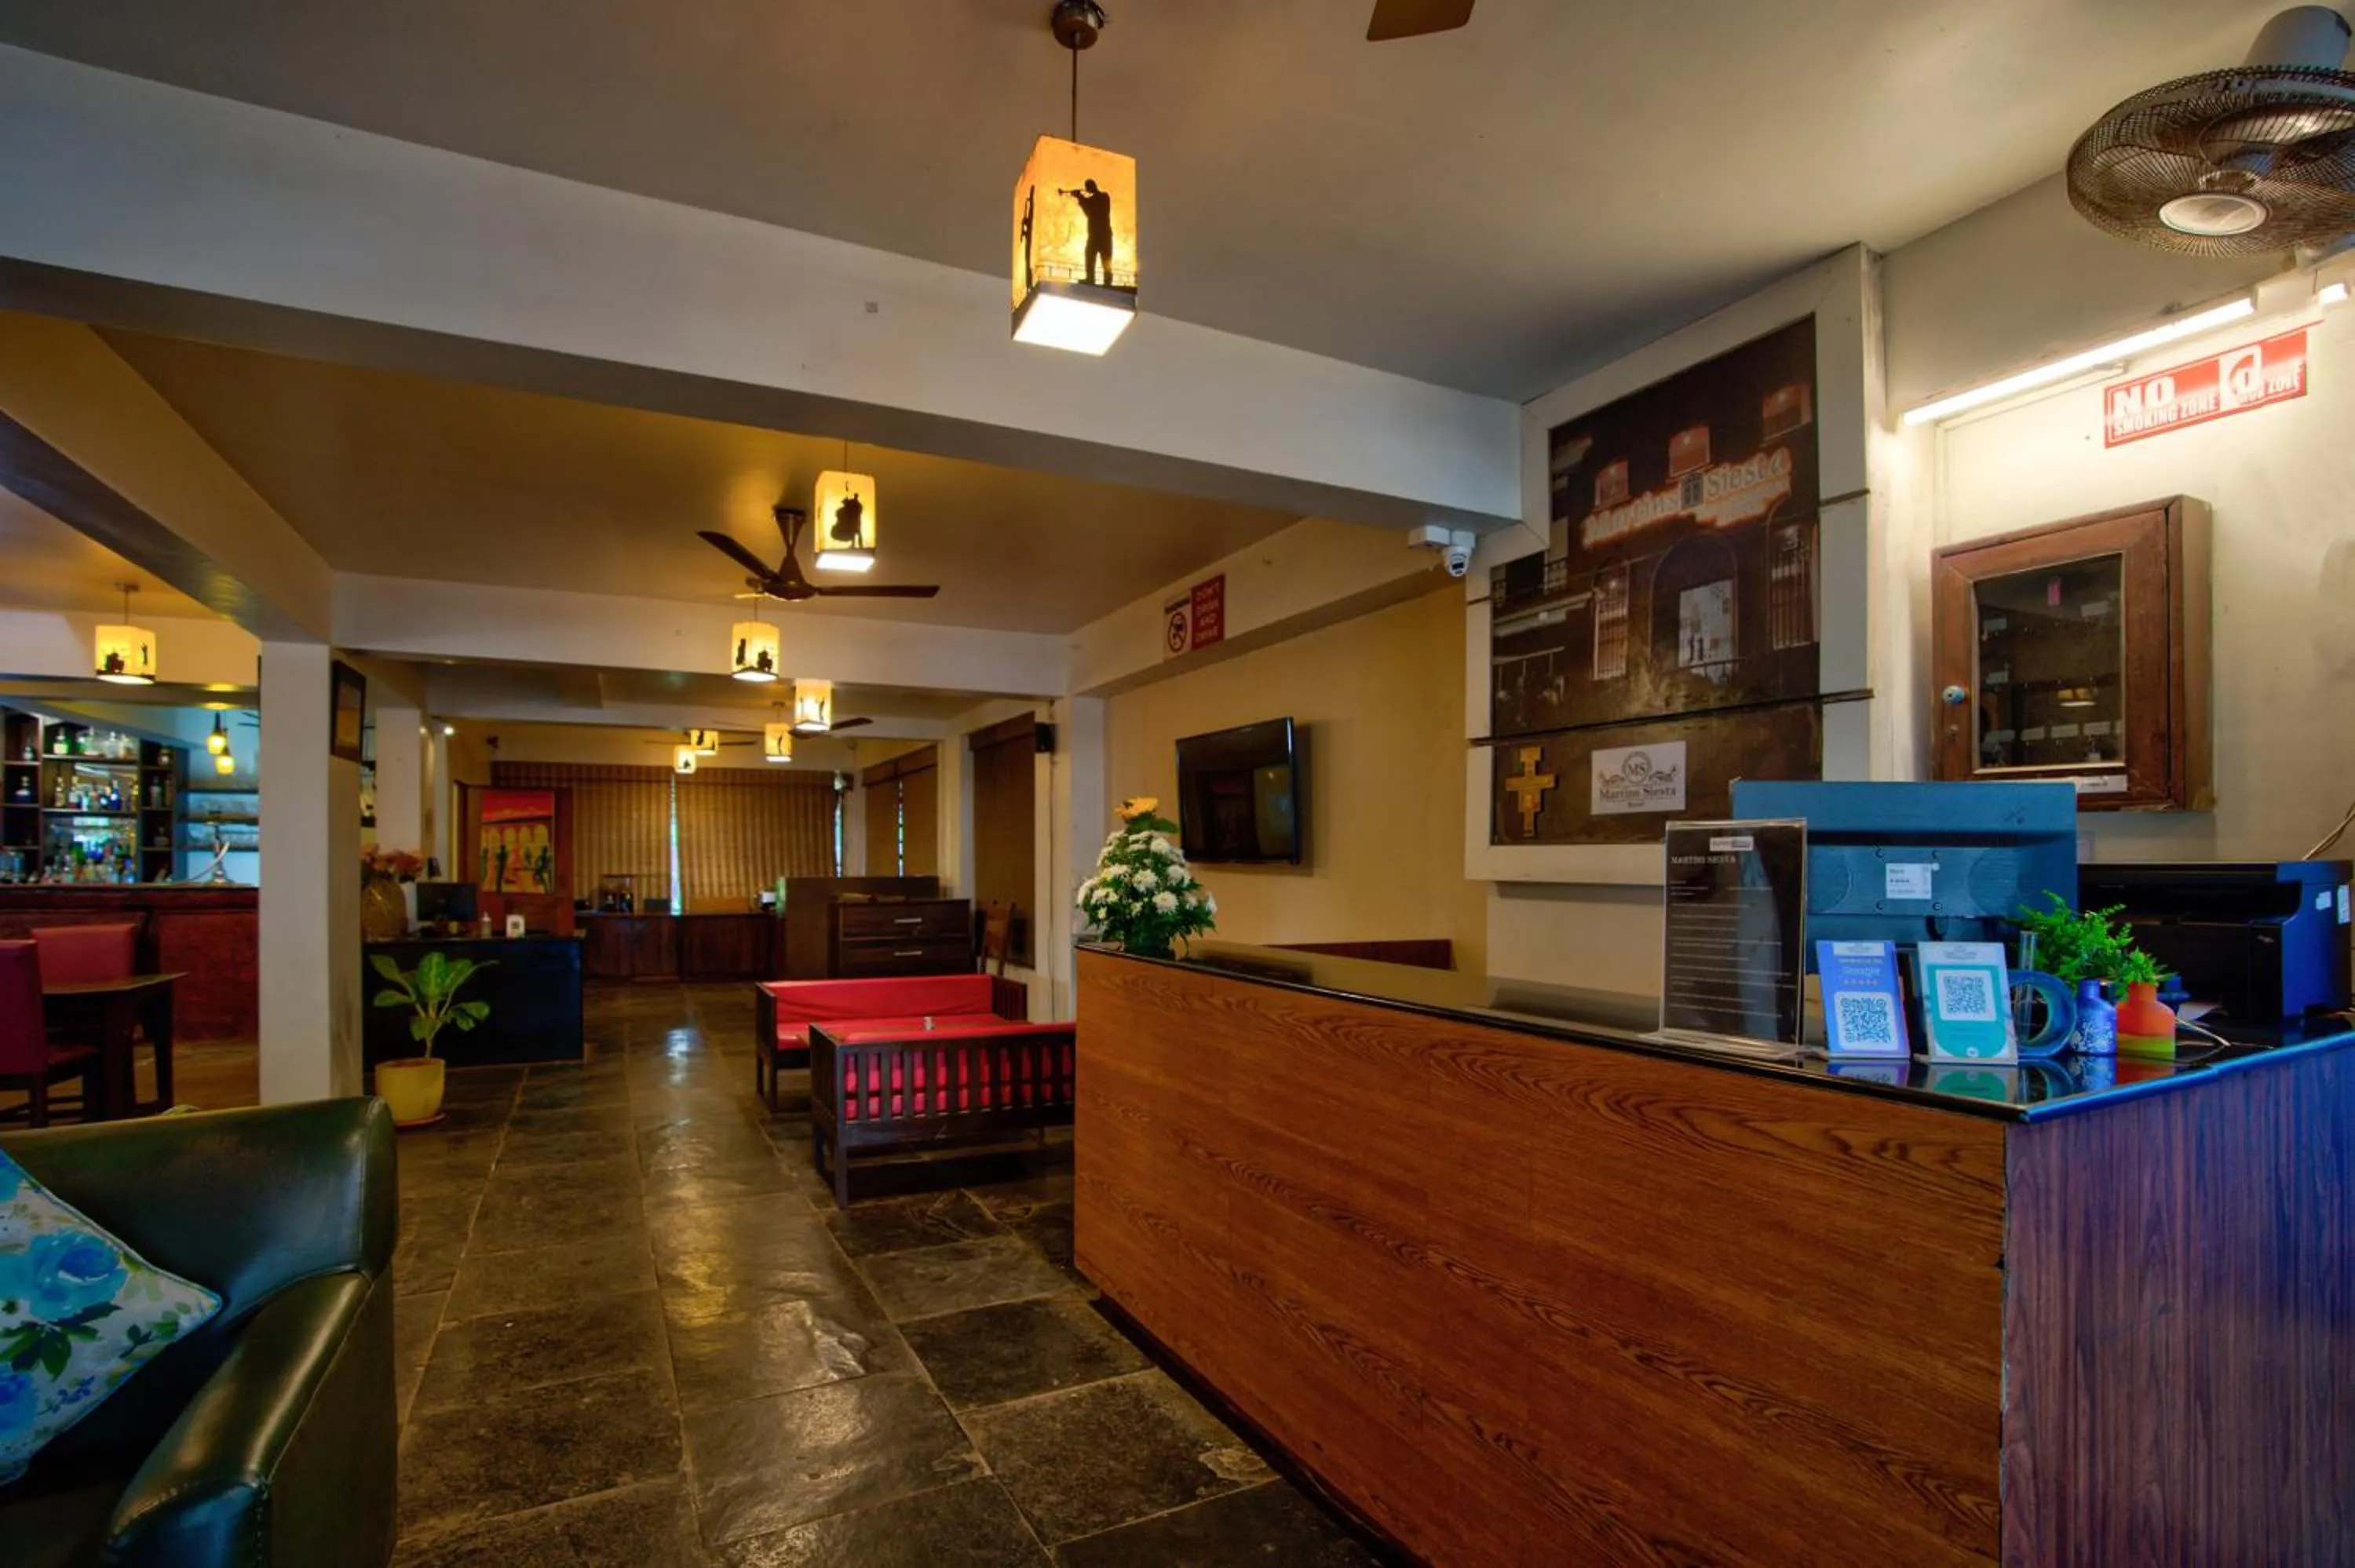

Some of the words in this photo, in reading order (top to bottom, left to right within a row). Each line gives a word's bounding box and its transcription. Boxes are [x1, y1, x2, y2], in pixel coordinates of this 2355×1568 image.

[2113, 376, 2175, 421] NO
[2113, 404, 2178, 435] SMOKING
[2180, 392, 2219, 419] ZONE
[1706, 448, 1791, 497] Siesta
[1627, 761, 1647, 777] MS
[1643, 786, 1676, 799] Siesta
